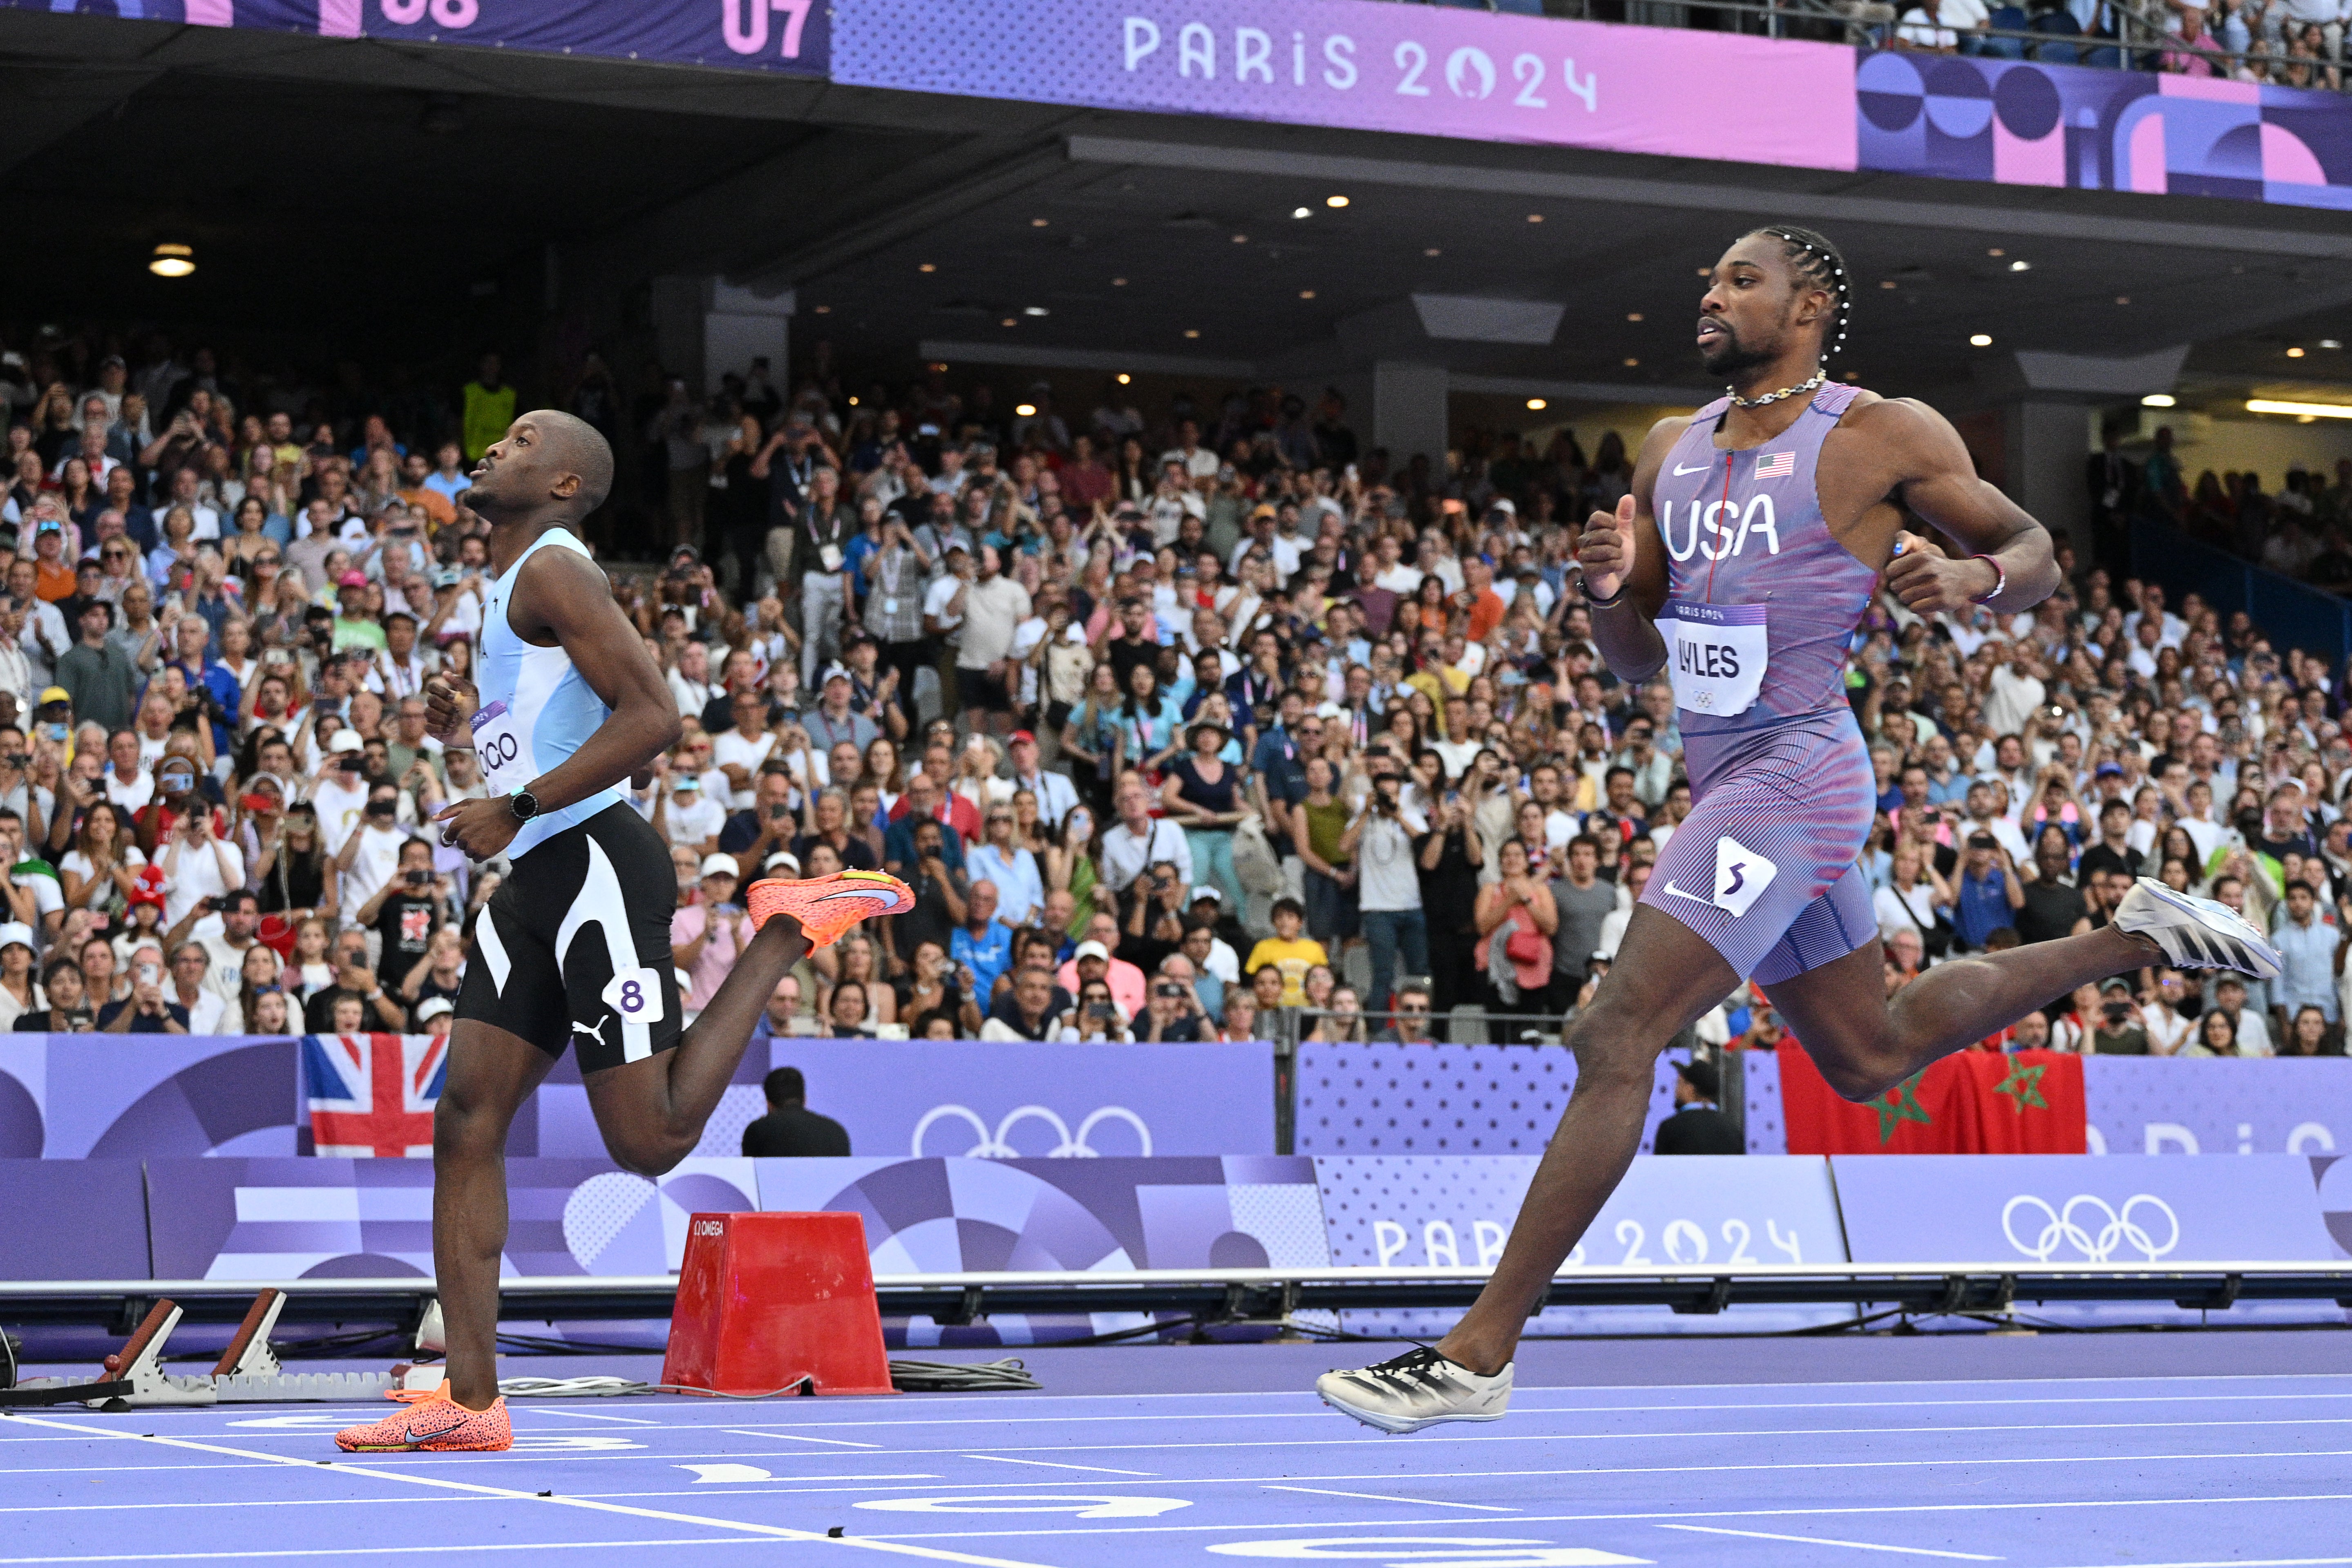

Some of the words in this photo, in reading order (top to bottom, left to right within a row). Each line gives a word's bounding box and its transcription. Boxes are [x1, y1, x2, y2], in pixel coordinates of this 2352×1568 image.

[1393, 41, 1597, 112] 2024
[1663, 494, 1779, 562] USA
[1678, 638, 1740, 678] LYLES
[1723, 862, 1747, 895] 5
[621, 980, 644, 1013] 8
[701, 1220, 723, 1236] OMEGA
[1614, 1218, 1802, 1265] 2024
